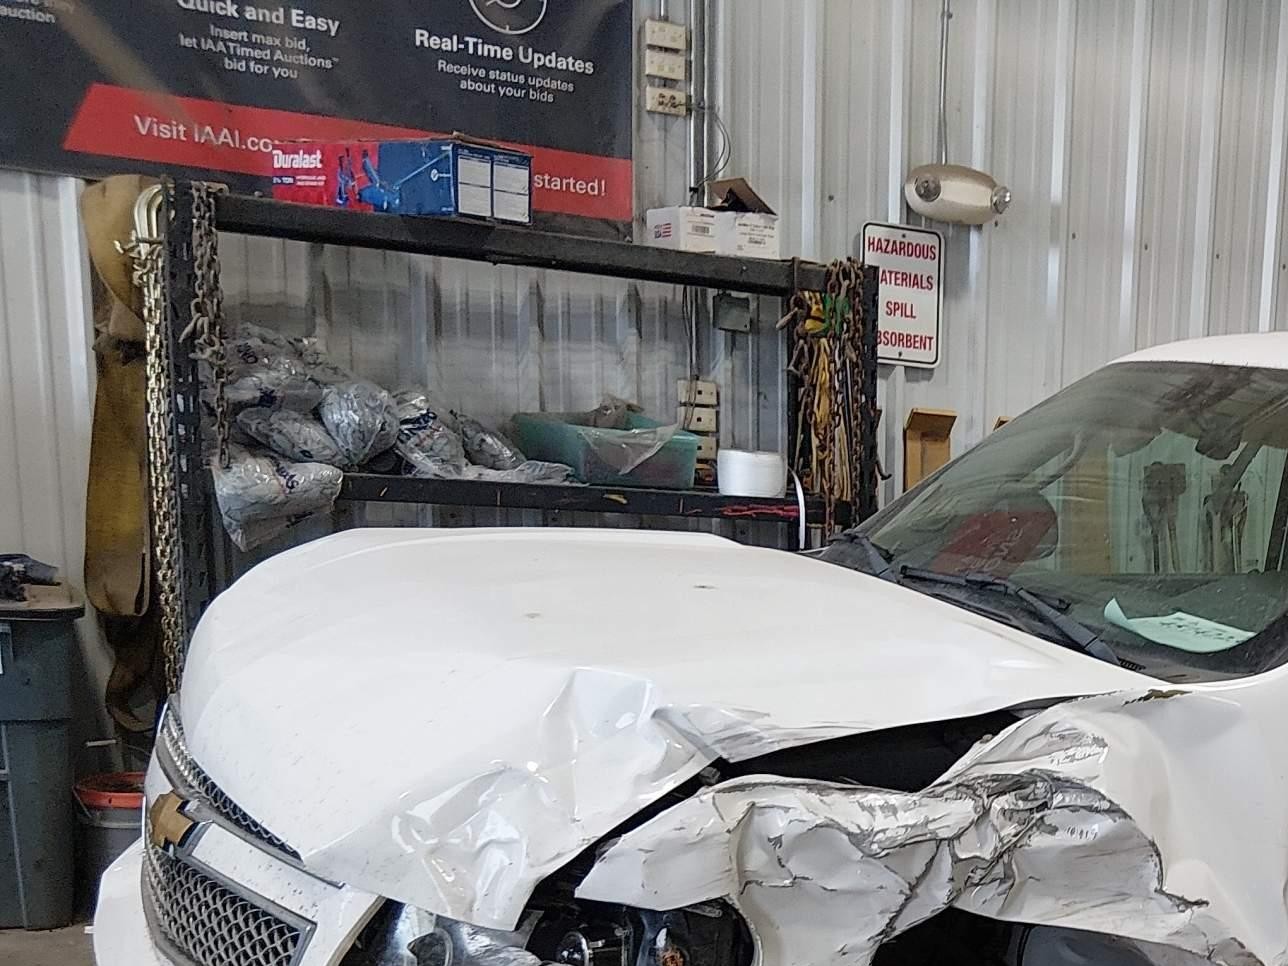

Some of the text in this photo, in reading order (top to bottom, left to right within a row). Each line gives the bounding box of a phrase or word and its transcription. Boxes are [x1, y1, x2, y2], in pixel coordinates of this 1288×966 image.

[0, 5, 56, 23] auction
[244, 8, 285, 25] and
[291, 9, 340, 36] Easy
[178, 33, 198, 49] let
[201, 38, 227, 54] IAA
[227, 42, 271, 60] Timed
[209, 24, 311, 52] Insert max bid,
[414, 29, 595, 74] Real-Time Updates
[224, 57, 298, 79] bid for you
[437, 59, 575, 93] Receive status updates
[459, 78, 554, 103] about your bids
[133, 114, 606, 197] Visit IAAI.co started!
[273, 149, 323, 169] Duralast
[867, 235, 937, 261] HAZARDOUS
[880, 269, 934, 291] ATERIALS
[885, 301, 916, 319] SPILL
[876, 330, 934, 351] BSORBENT
